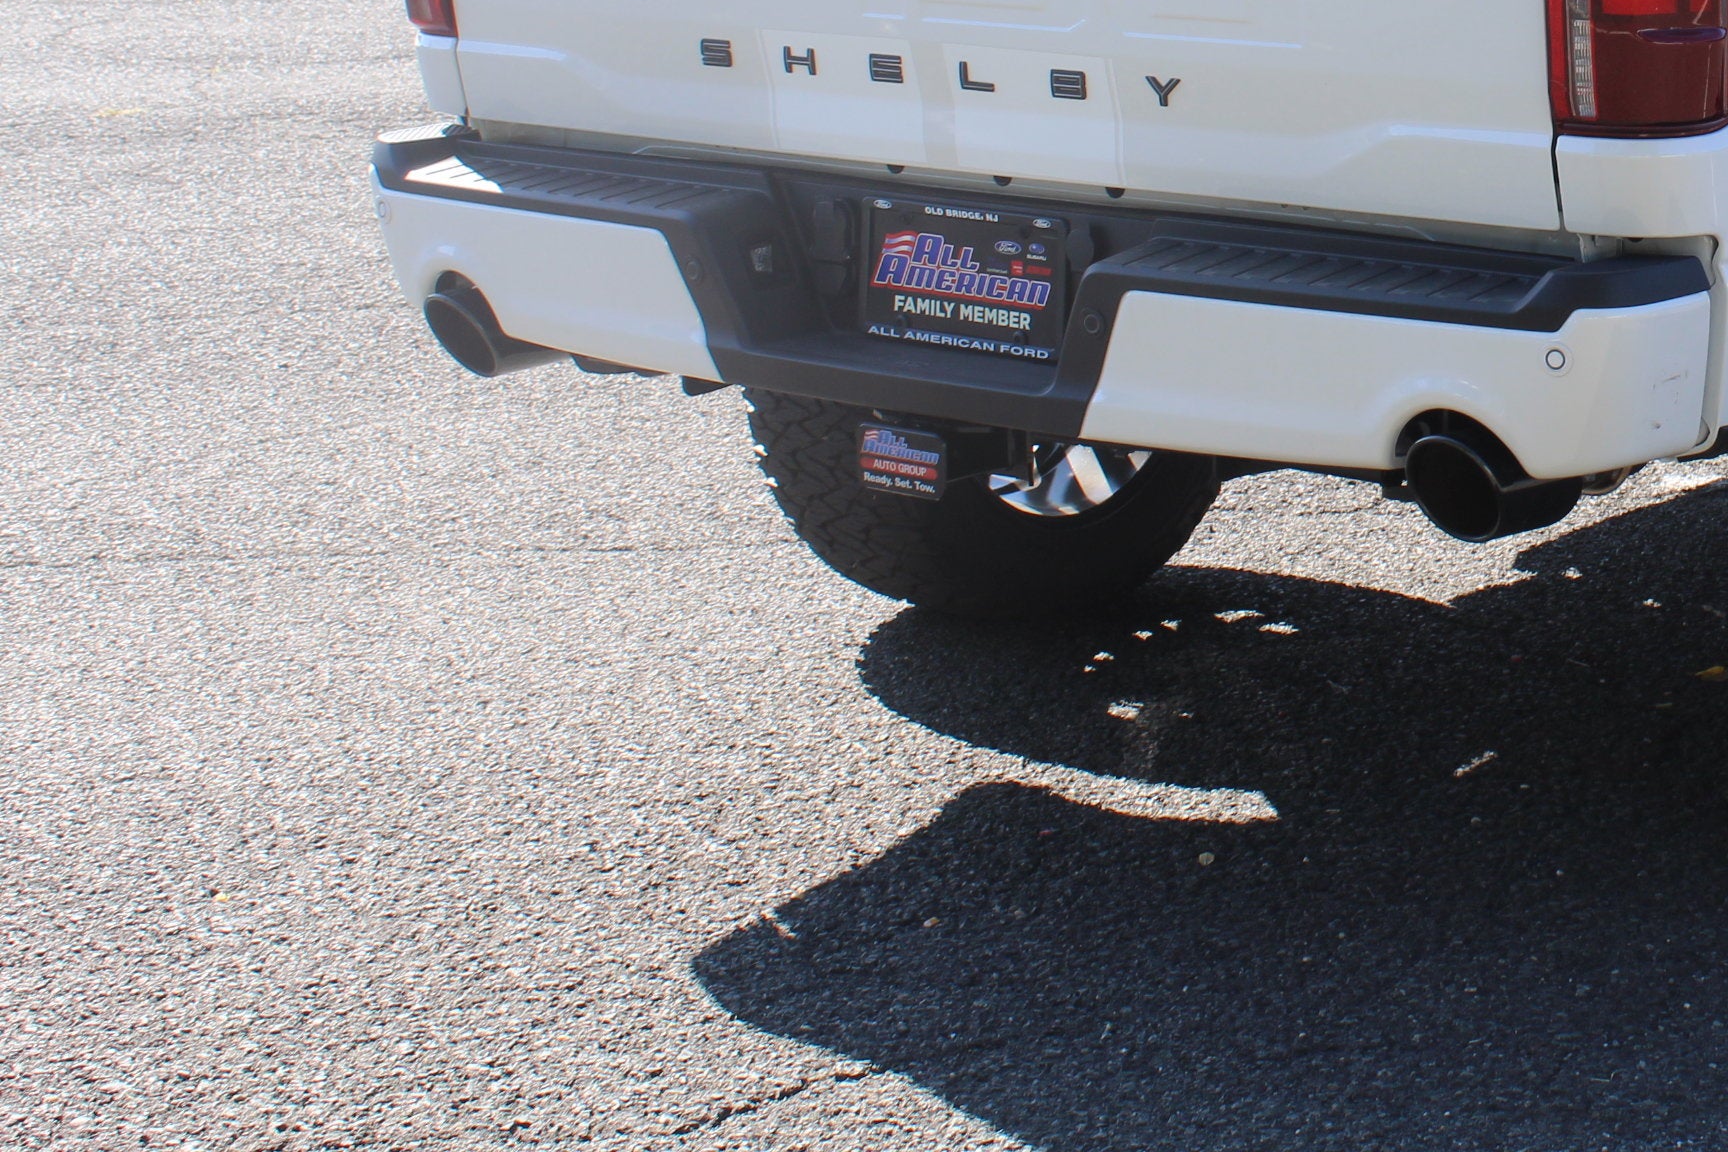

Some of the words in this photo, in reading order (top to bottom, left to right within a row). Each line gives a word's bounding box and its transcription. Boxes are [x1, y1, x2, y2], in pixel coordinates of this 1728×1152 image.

[700, 38, 1181, 107] SHELBY
[924, 206, 943, 216] OLD
[985, 213, 999, 223] NJ
[912, 232, 980, 272] ALL
[874, 253, 1051, 307] AMERICAN
[894, 294, 955, 319] FAMILY
[959, 306, 1031, 330] MEMBER
[868, 324, 900, 338] ALL
[903, 329, 995, 352] AMERICAN
[1000, 344, 1049, 360] FORD
[862, 439, 940, 465] AMERICAN
[879, 430, 908, 448] ALL
[873, 458, 897, 471] AUTO
[898, 463, 927, 477] GROUP
[894, 477, 912, 489] Set.
[914, 480, 936, 493] Tow.
